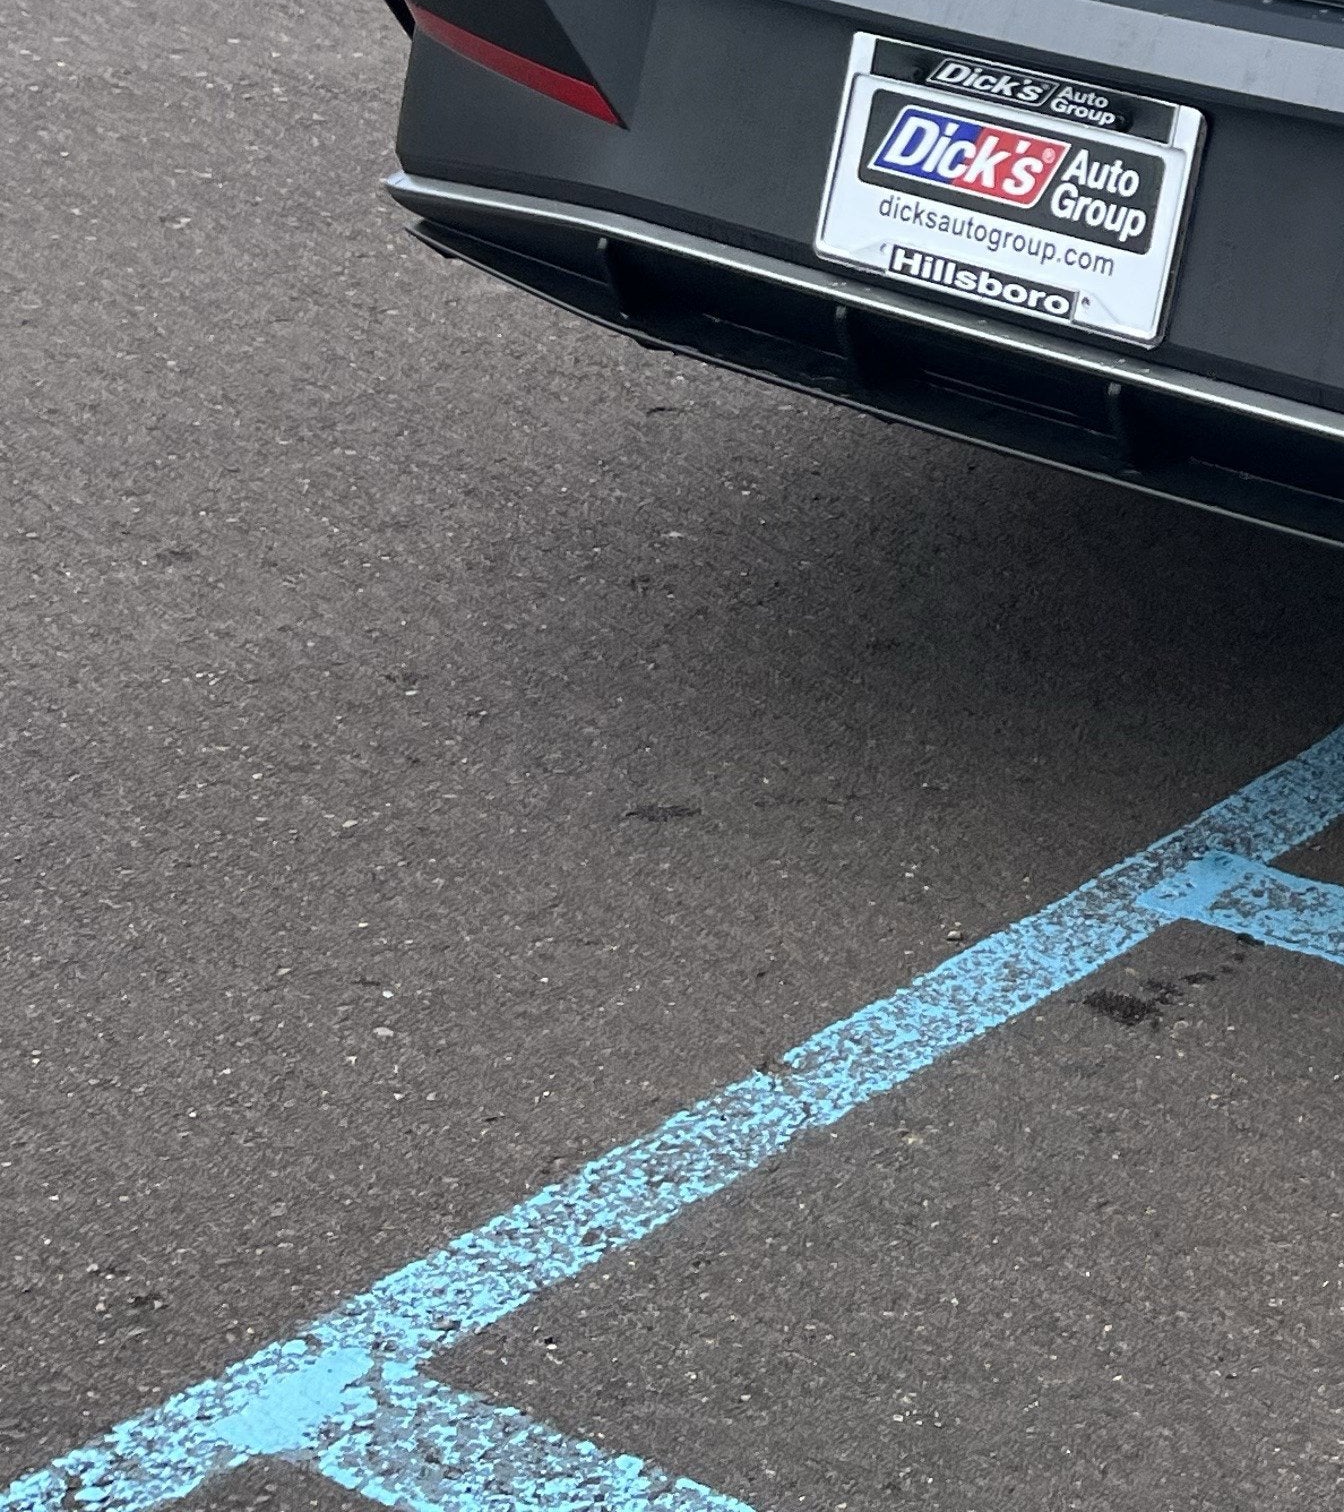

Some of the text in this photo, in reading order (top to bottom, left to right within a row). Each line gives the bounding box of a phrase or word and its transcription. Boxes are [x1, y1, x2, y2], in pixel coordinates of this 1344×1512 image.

[935, 62, 1044, 103] Dick's
[1057, 85, 1110, 109] Auto
[1050, 97, 1116, 126] Group
[883, 114, 1045, 196] Dick's
[1061, 148, 1140, 199] Auto
[878, 193, 1115, 277] dicksautogroup.com
[1049, 182, 1147, 243] Group
[891, 244, 1071, 317] Hillsboro
